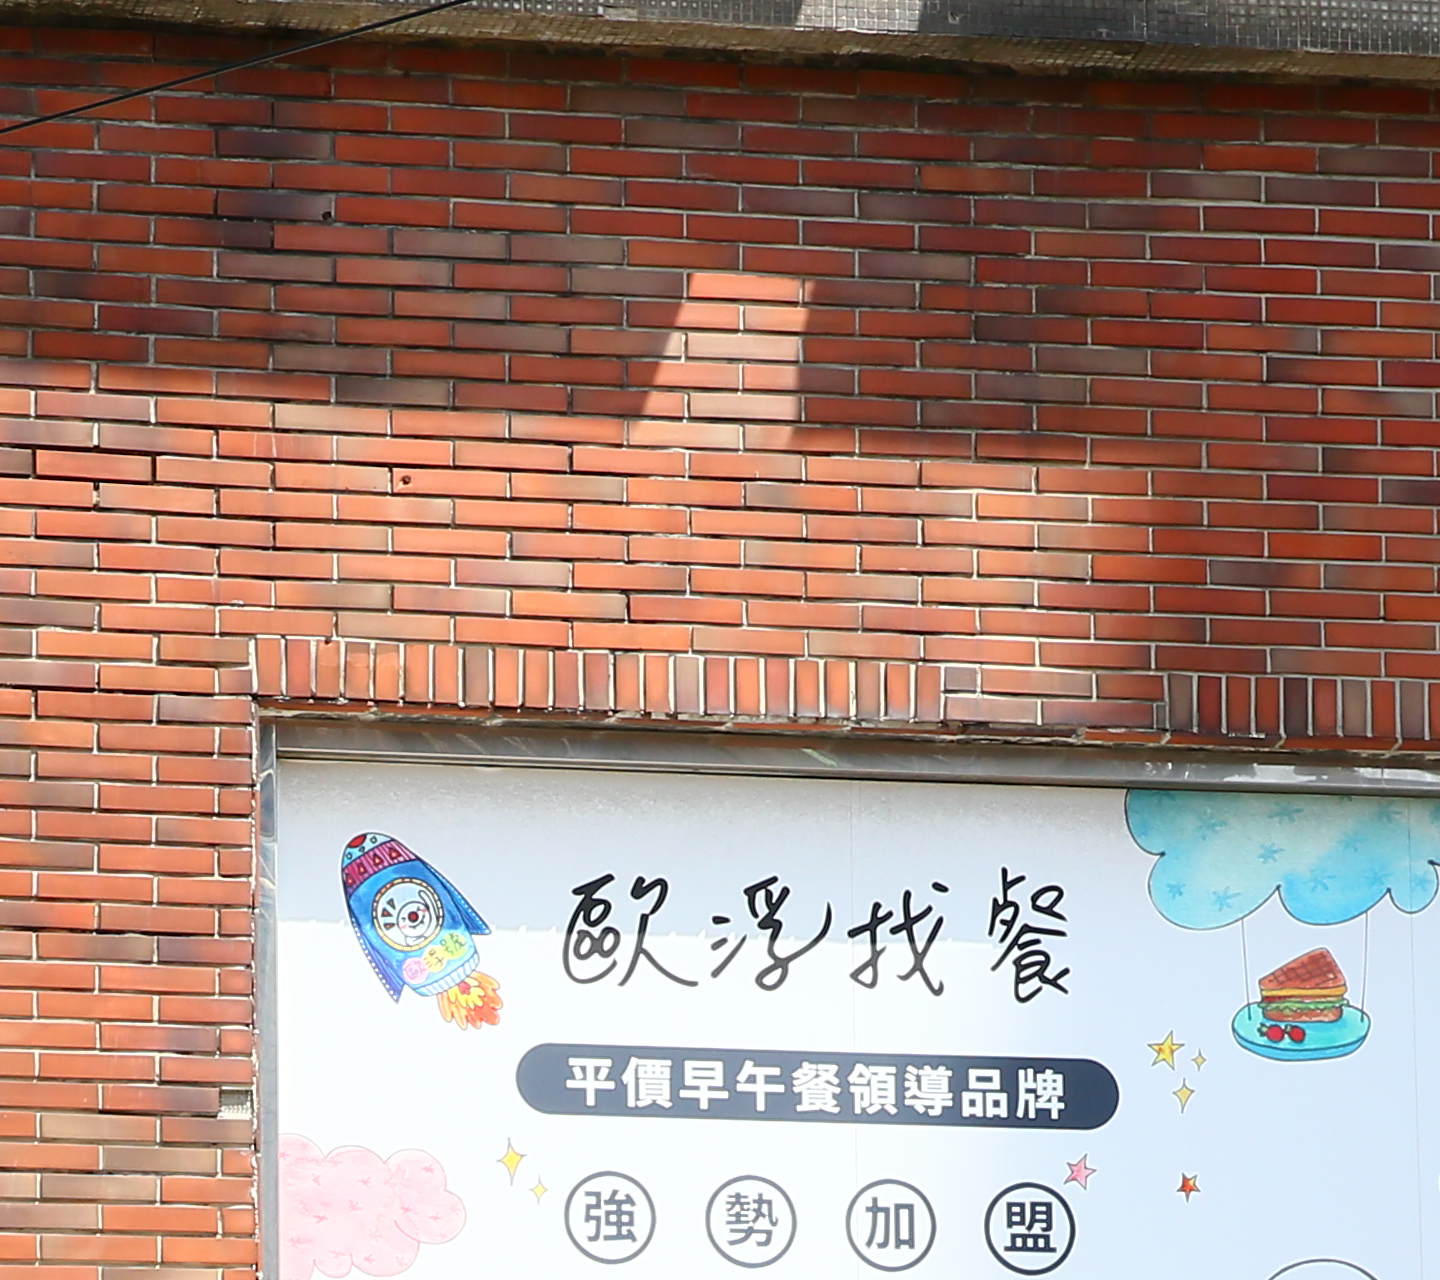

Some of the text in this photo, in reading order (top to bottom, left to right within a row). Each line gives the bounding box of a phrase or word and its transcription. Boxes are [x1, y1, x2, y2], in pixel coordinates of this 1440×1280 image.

[560, 864, 1072, 1004] 歐浮找餐
[564, 1055, 1067, 1123] 平價早午餐領導品牌
